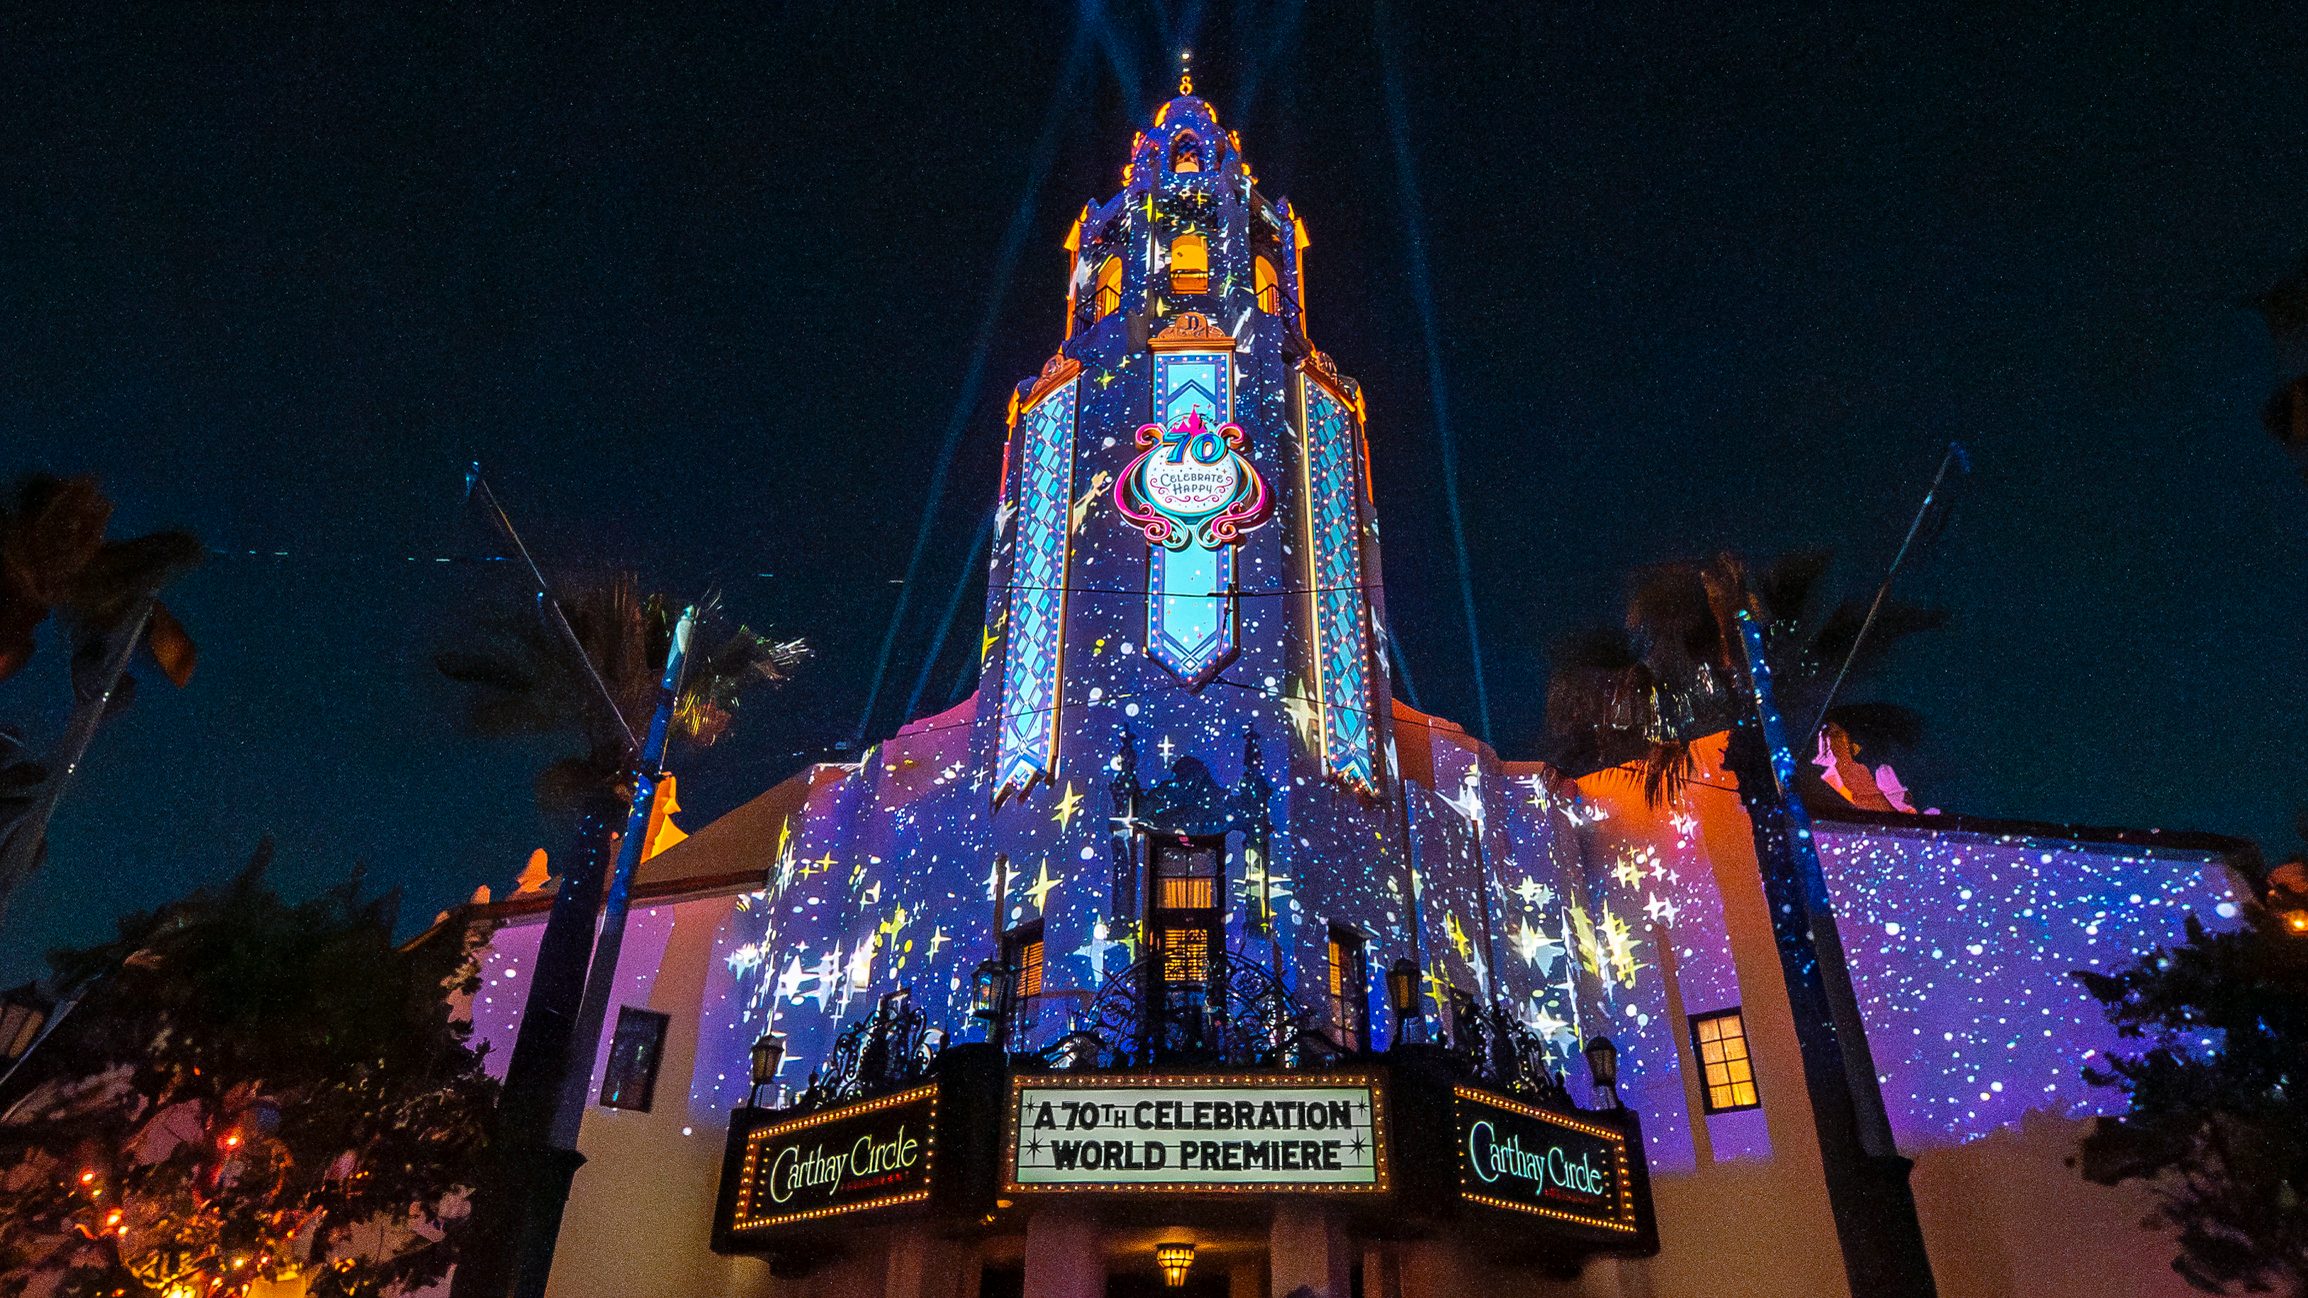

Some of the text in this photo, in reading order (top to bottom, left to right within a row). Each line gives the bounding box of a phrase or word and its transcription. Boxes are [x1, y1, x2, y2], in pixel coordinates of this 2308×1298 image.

[1185, 316, 1200, 331] D
[1162, 431, 1228, 466] 70
[1160, 473, 1224, 487] CELEBRATE
[1172, 483, 1212, 495] HAPPY
[1034, 1100, 1352, 1130] A 70TH CELEBRATION
[770, 1125, 918, 1203] Carthay Circle
[1051, 1140, 1342, 1170] WORLD PREMIERE
[1470, 1121, 1603, 1196] Carthay Circle
